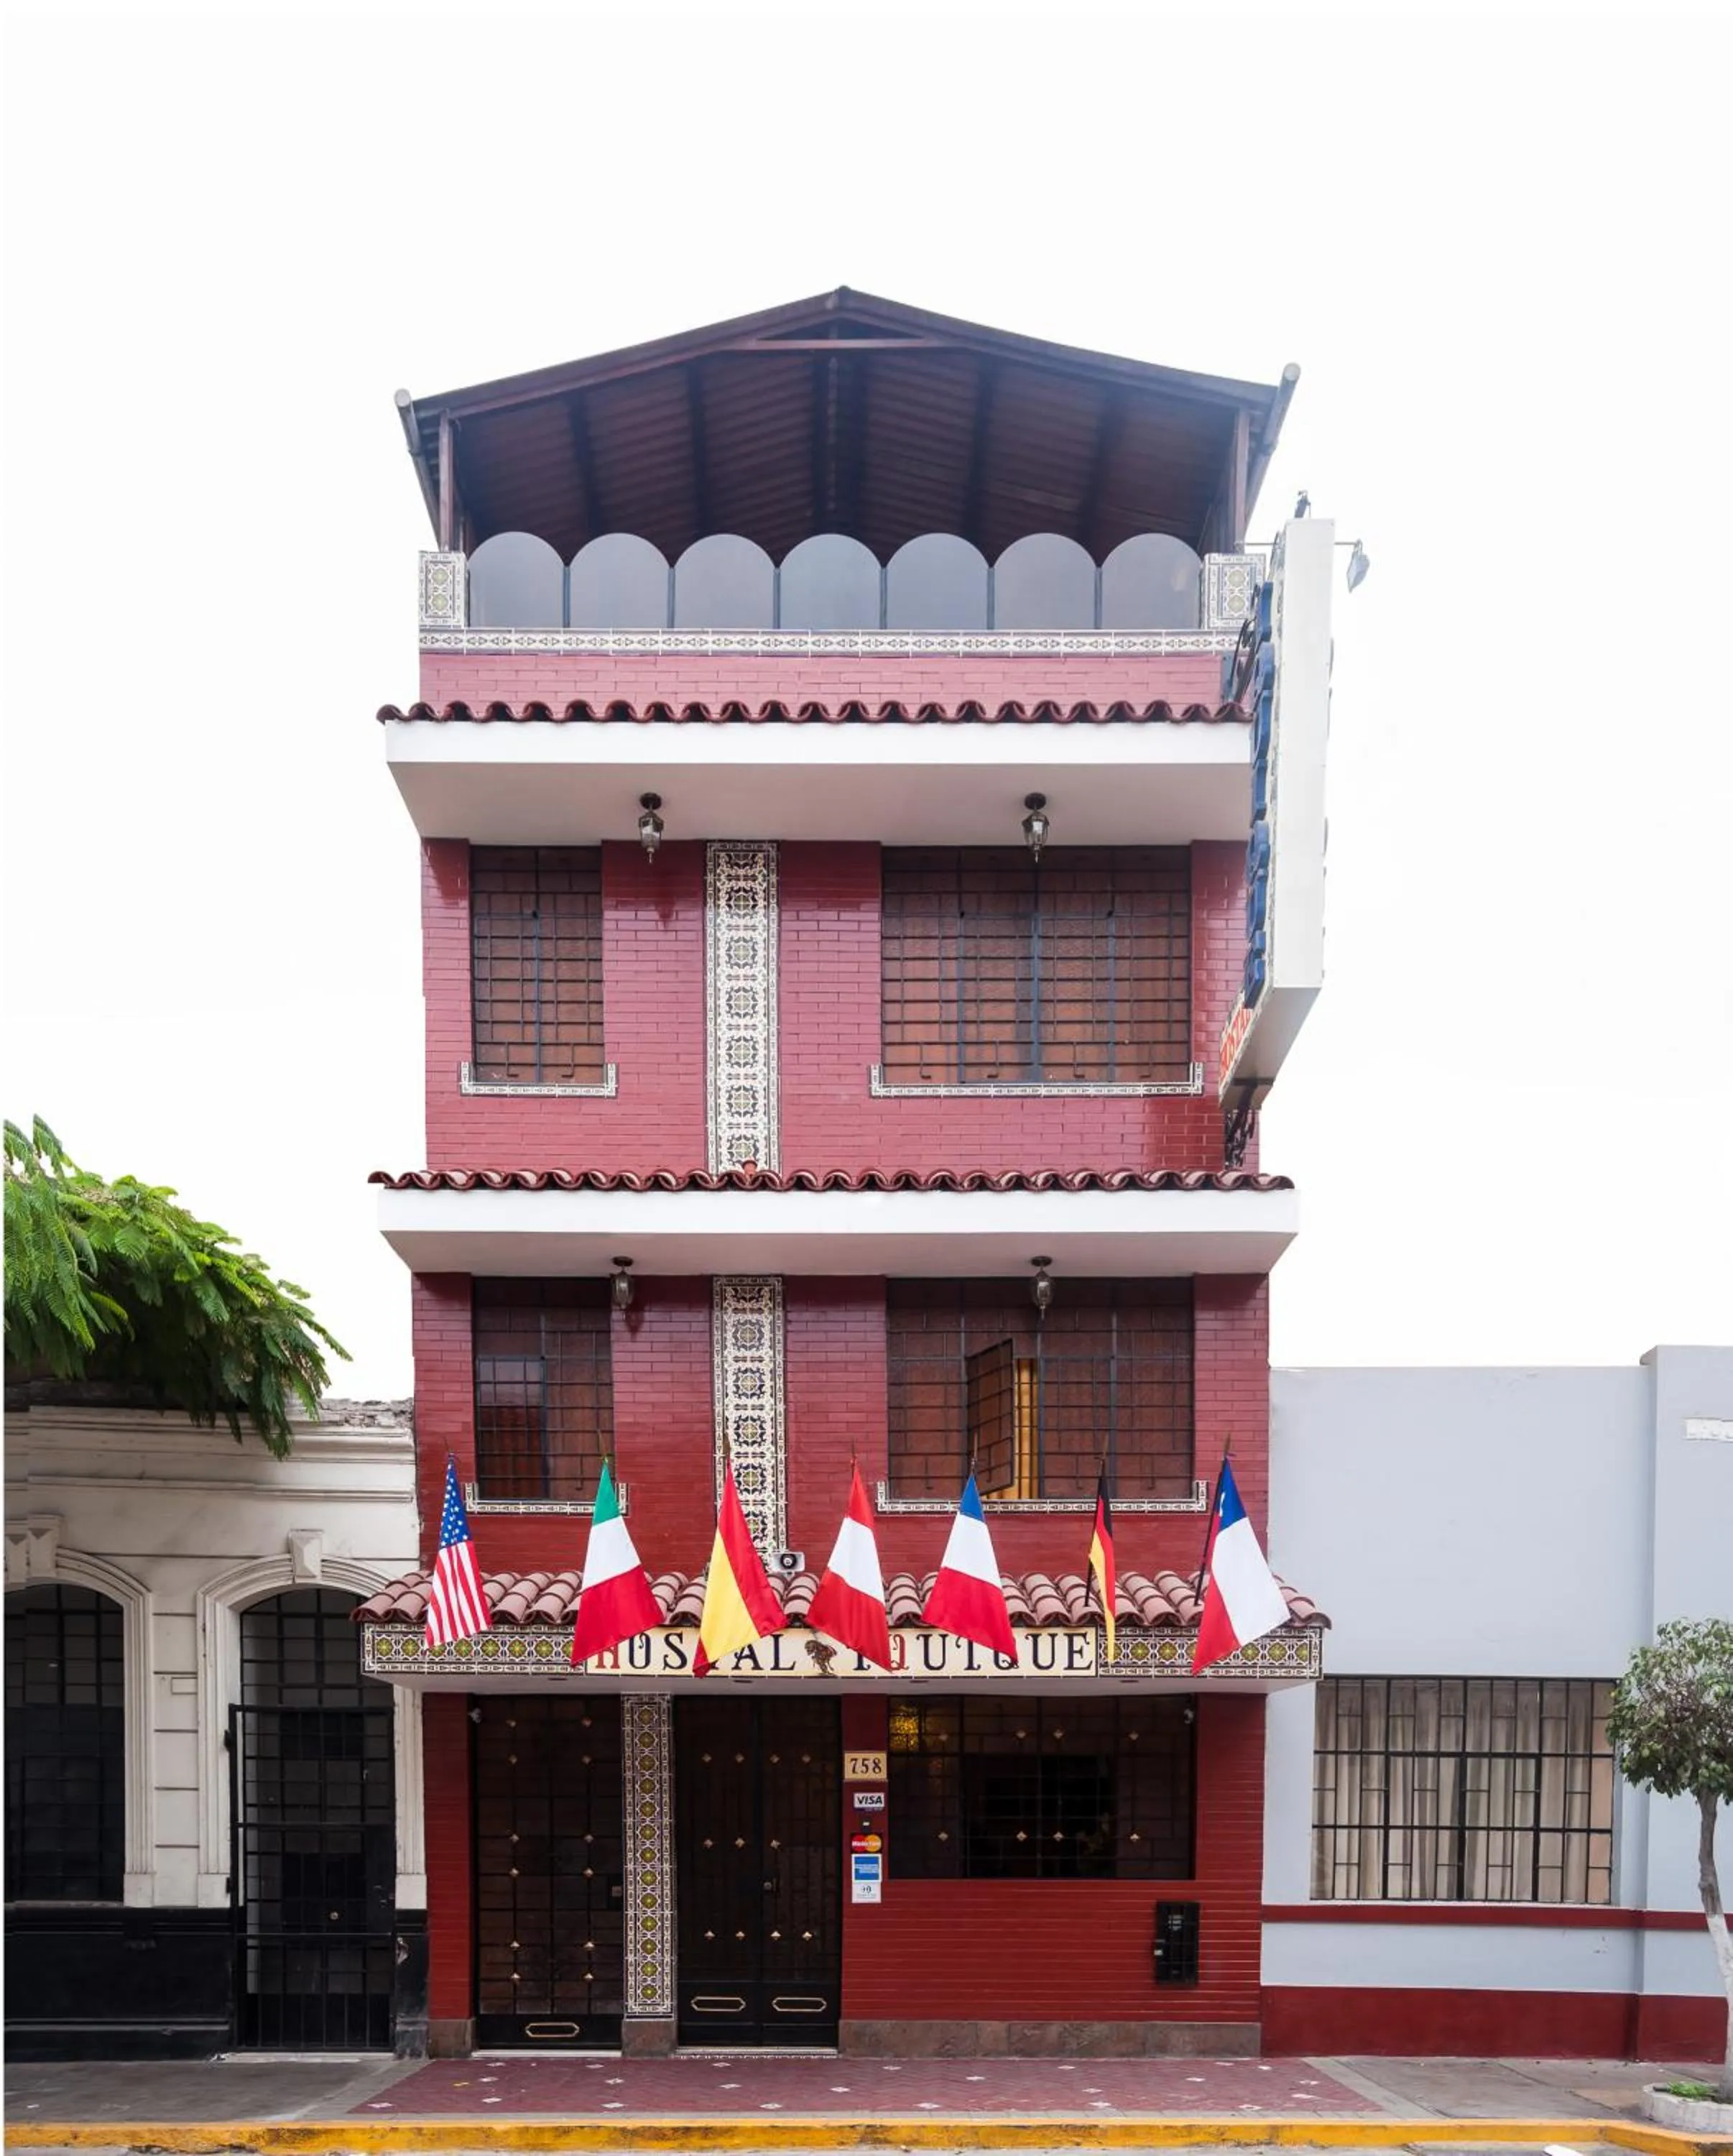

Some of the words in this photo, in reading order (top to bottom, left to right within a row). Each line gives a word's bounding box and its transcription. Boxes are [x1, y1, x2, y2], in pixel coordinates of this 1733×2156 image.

[595, 1632, 796, 1670] HOSAL
[850, 1757, 882, 1774] 758
[857, 1795, 883, 1805] VISA
